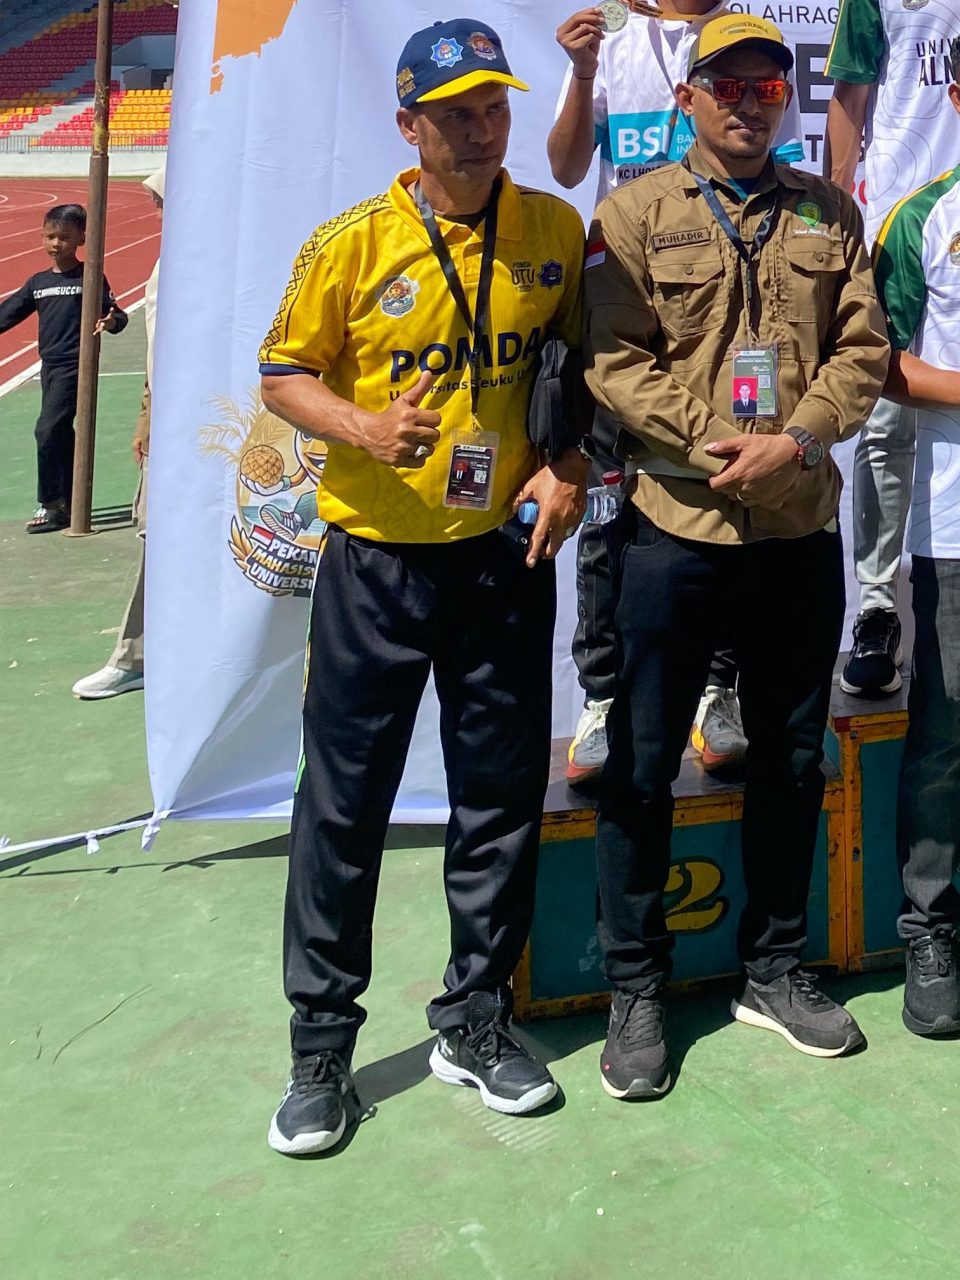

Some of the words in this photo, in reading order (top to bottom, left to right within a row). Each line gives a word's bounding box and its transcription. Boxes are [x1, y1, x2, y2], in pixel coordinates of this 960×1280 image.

[617, 124, 670, 159] BSI
[658, 232, 704, 246] MUHADIR
[511, 268, 535, 285] UTU
[390, 326, 542, 383] POMDA
[269, 538, 318, 564] PEKAN
[250, 563, 315, 589] UNIVERSI
[663, 861, 724, 931] 2
